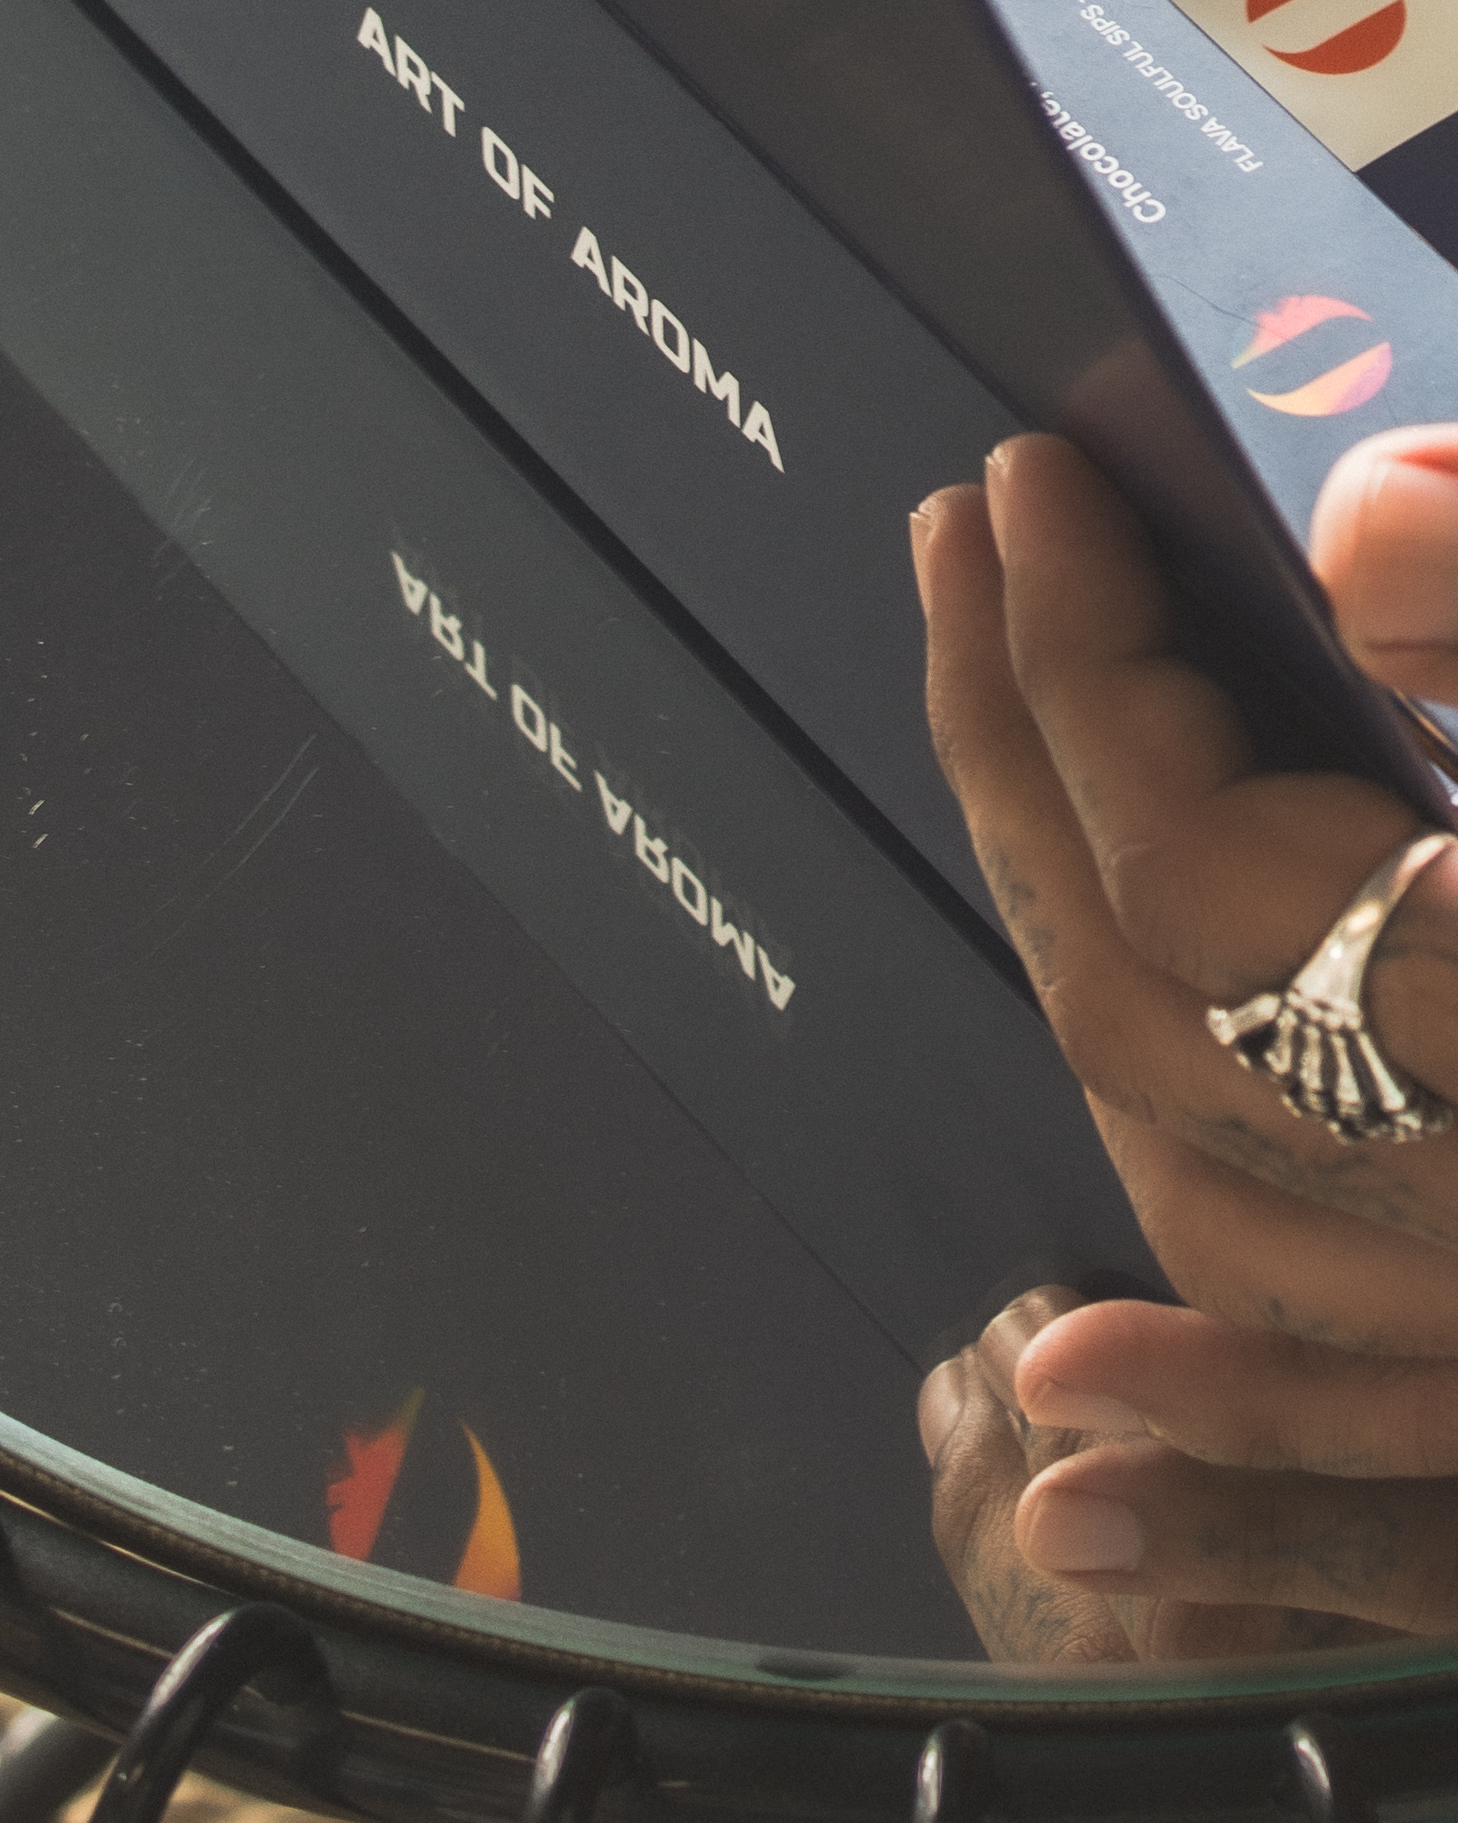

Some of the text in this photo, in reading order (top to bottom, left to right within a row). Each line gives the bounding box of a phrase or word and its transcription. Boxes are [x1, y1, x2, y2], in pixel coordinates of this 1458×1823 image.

[1080, 4, 1130, 46] SIPS
[1122, 40, 1209, 122] SOULFUL
[1200, 116, 1264, 173] FLAVA
[356, 6, 785, 474] ART OF AROMA
